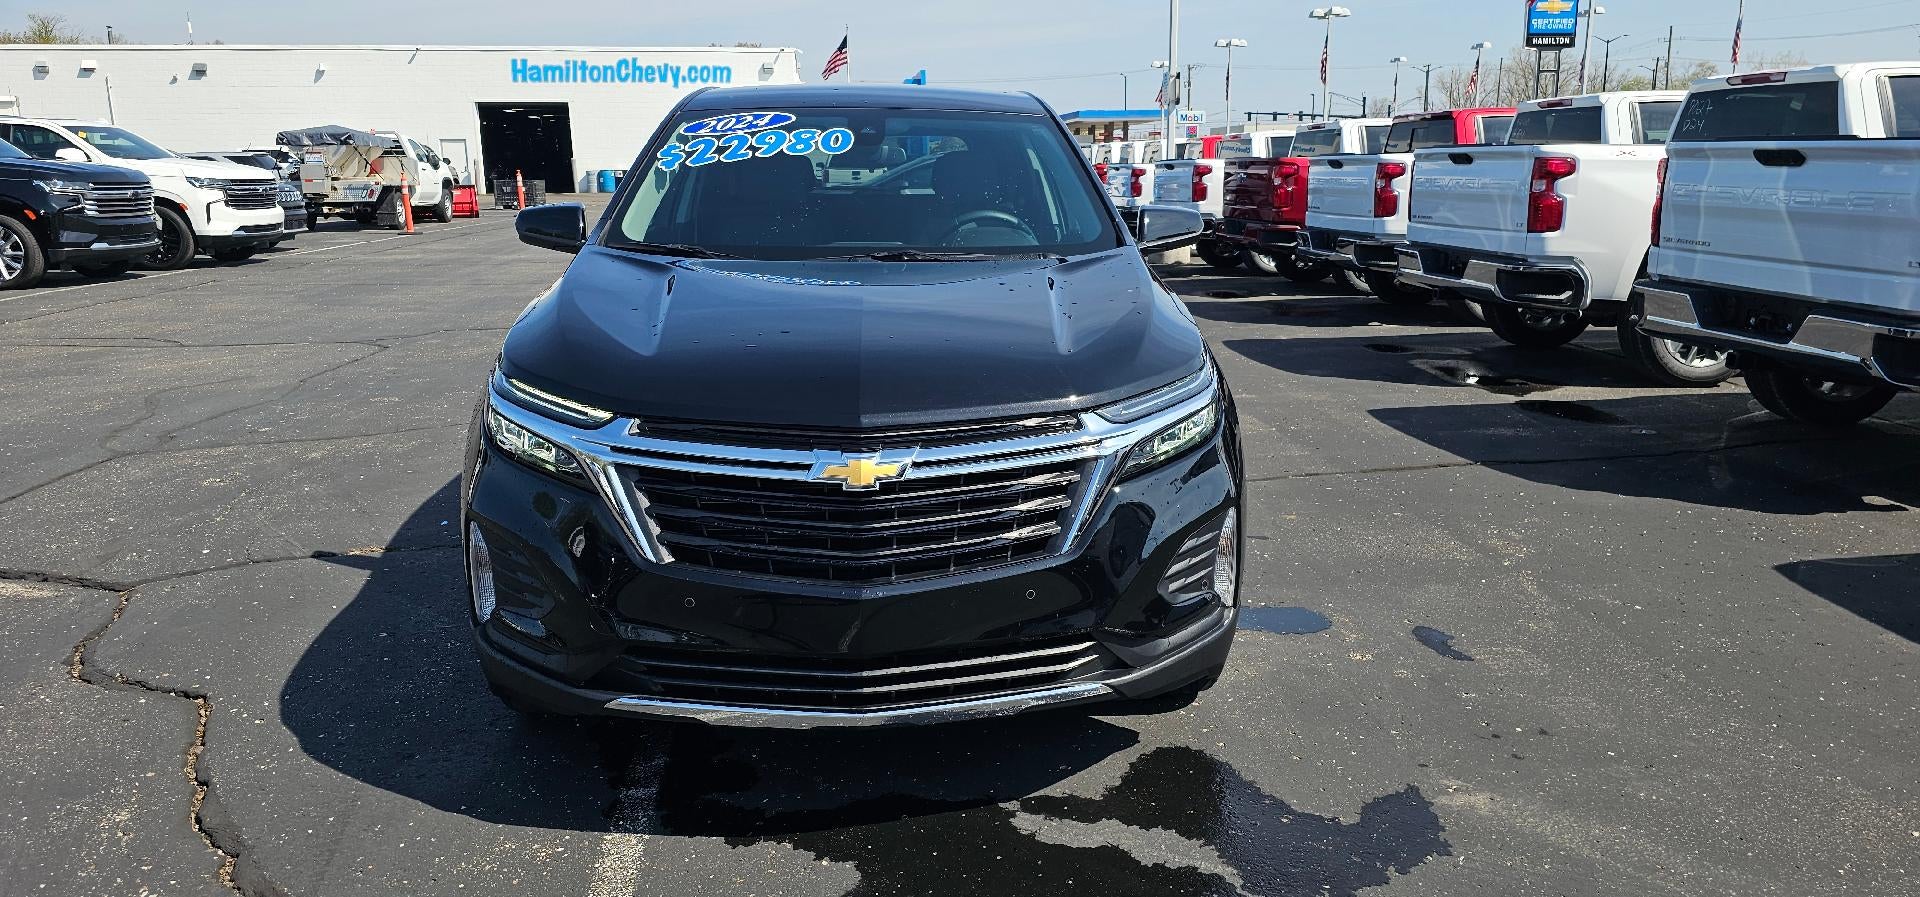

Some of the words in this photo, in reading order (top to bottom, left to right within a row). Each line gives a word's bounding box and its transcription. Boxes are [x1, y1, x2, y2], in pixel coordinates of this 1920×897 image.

[511, 57, 732, 88] HamiltonChevy.com
[700, 113, 775, 133] 2024
[1180, 114, 1203, 122] Mobil
[657, 127, 854, 171] $22980
